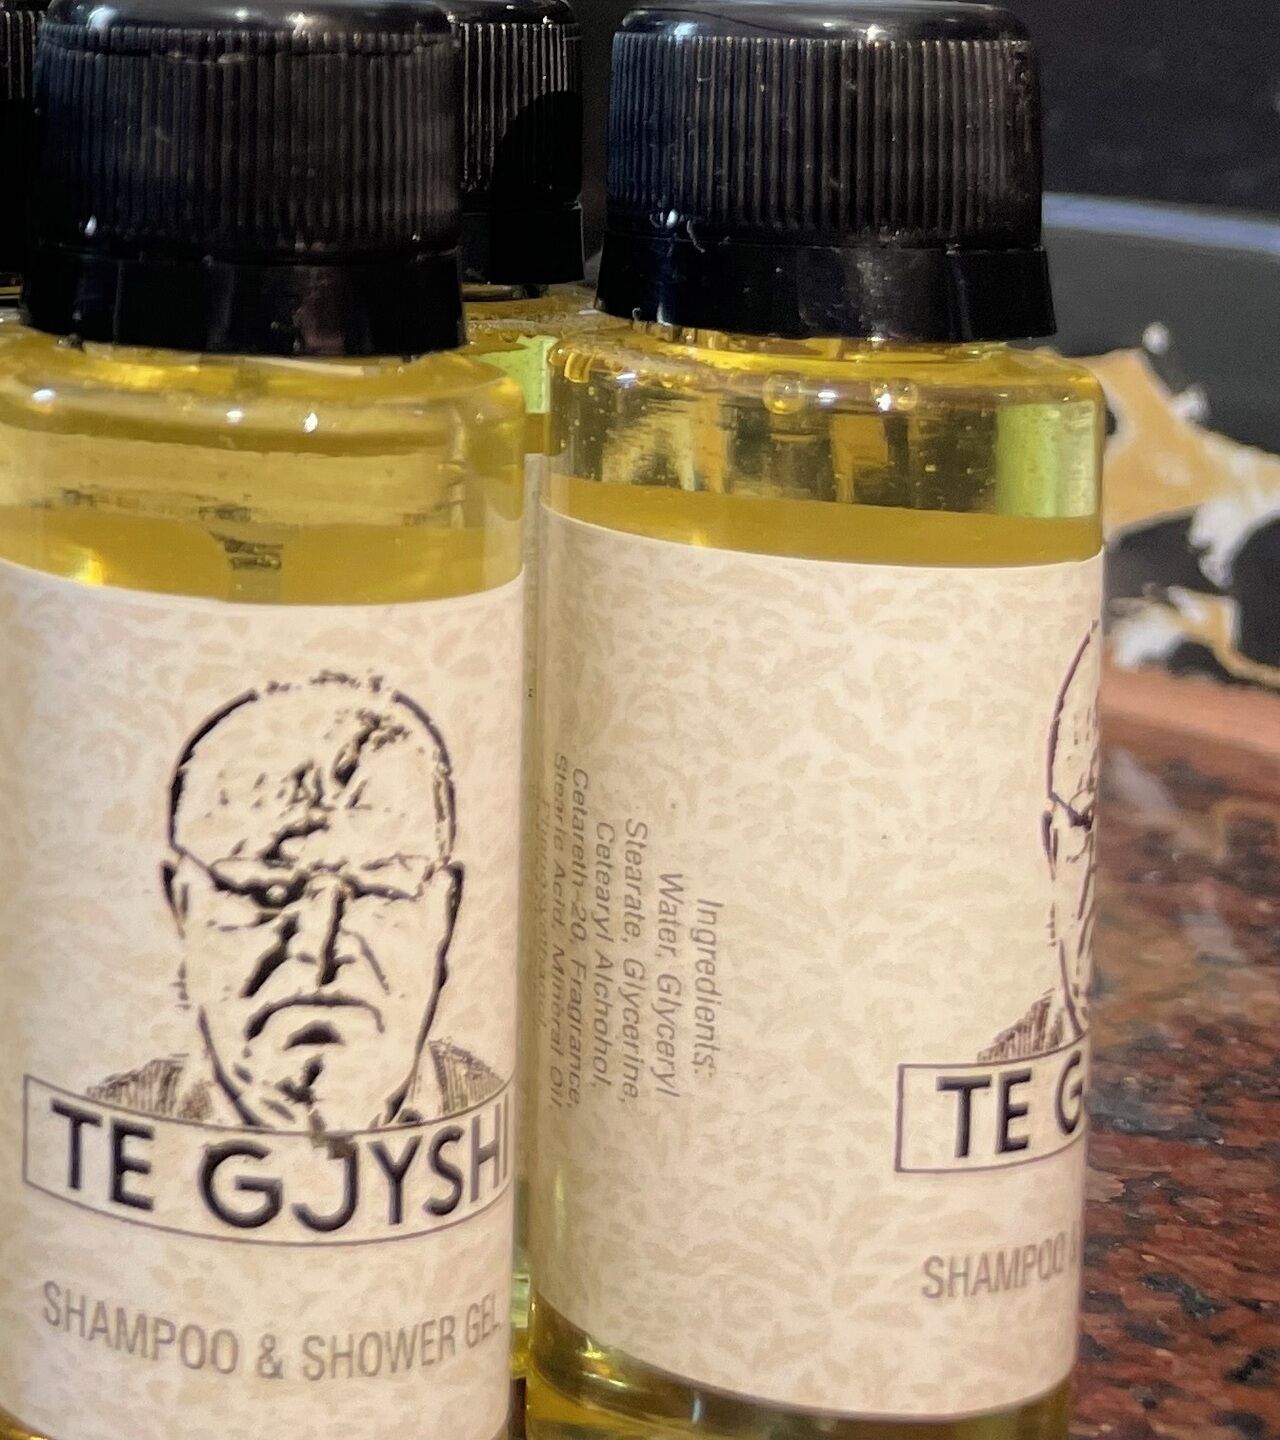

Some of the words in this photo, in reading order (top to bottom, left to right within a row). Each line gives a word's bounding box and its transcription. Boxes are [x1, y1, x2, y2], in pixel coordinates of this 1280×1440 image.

[553, 753, 568, 852] Stearic
[591, 822, 615, 943] Cetearyl
[620, 817, 648, 944] Stearate,
[654, 873, 685, 959] Water,
[567, 959, 587, 1108] Fragrance,
[617, 958, 646, 1104] Glycerine,
[651, 973, 683, 1098] Glyceryl
[690, 898, 724, 1079] Ingredients:
[50, 1098, 154, 1212] TE
[198, 1092, 509, 1233] GJYSHI
[936, 1067, 1032, 1158] TE
[43, 1280, 239, 1375] SHAMPOO
[256, 1334, 284, 1380] &
[302, 1319, 456, 1382] SHOWER
[466, 1292, 500, 1349] GEL
